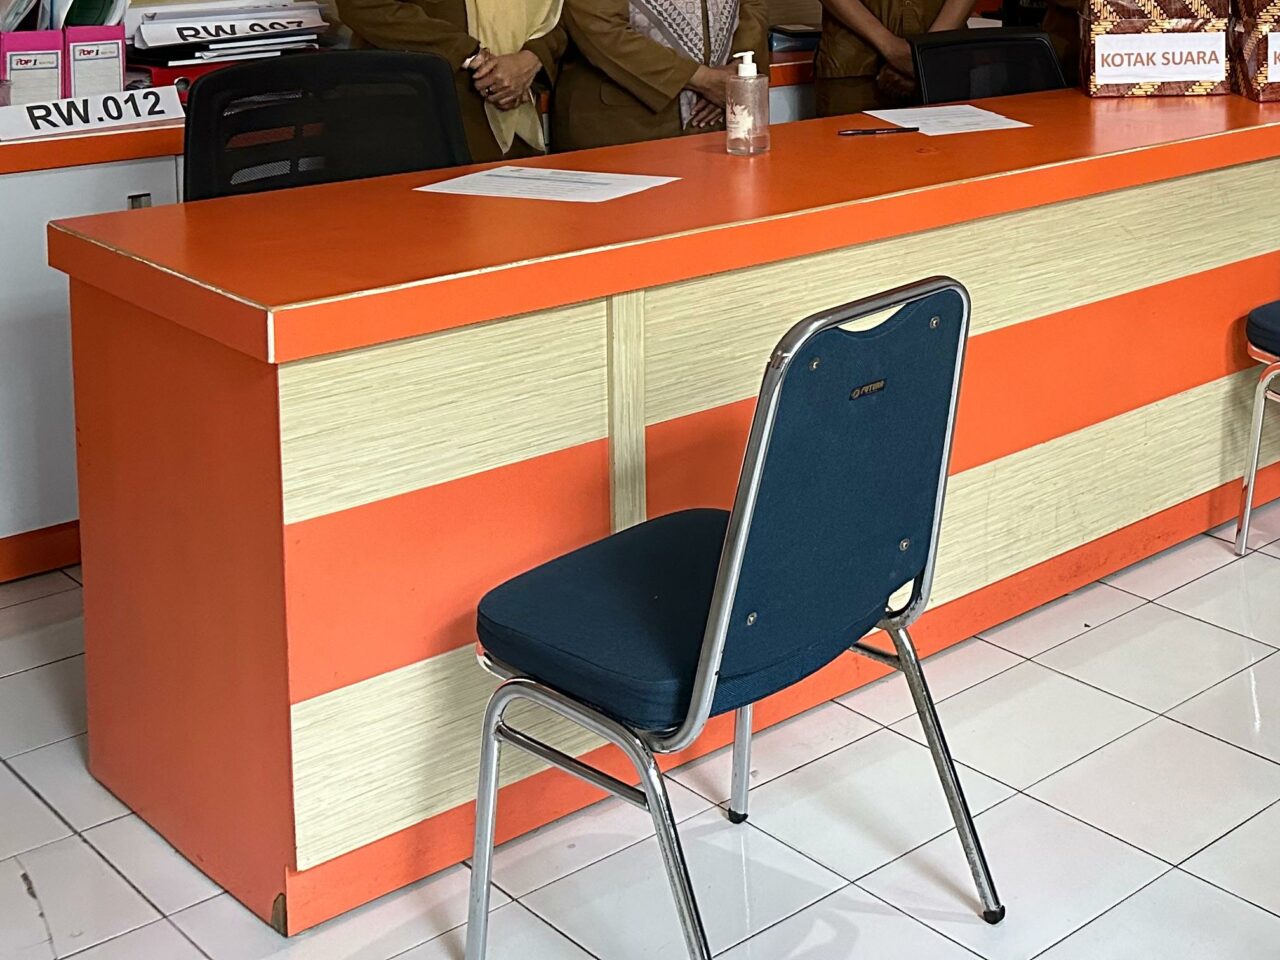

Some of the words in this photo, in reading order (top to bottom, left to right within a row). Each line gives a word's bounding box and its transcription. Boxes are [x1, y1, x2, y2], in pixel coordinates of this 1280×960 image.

[1100, 52, 1157, 68] KOTAK
[1161, 50, 1220, 66] SUARA
[26, 90, 166, 130] RW.012
